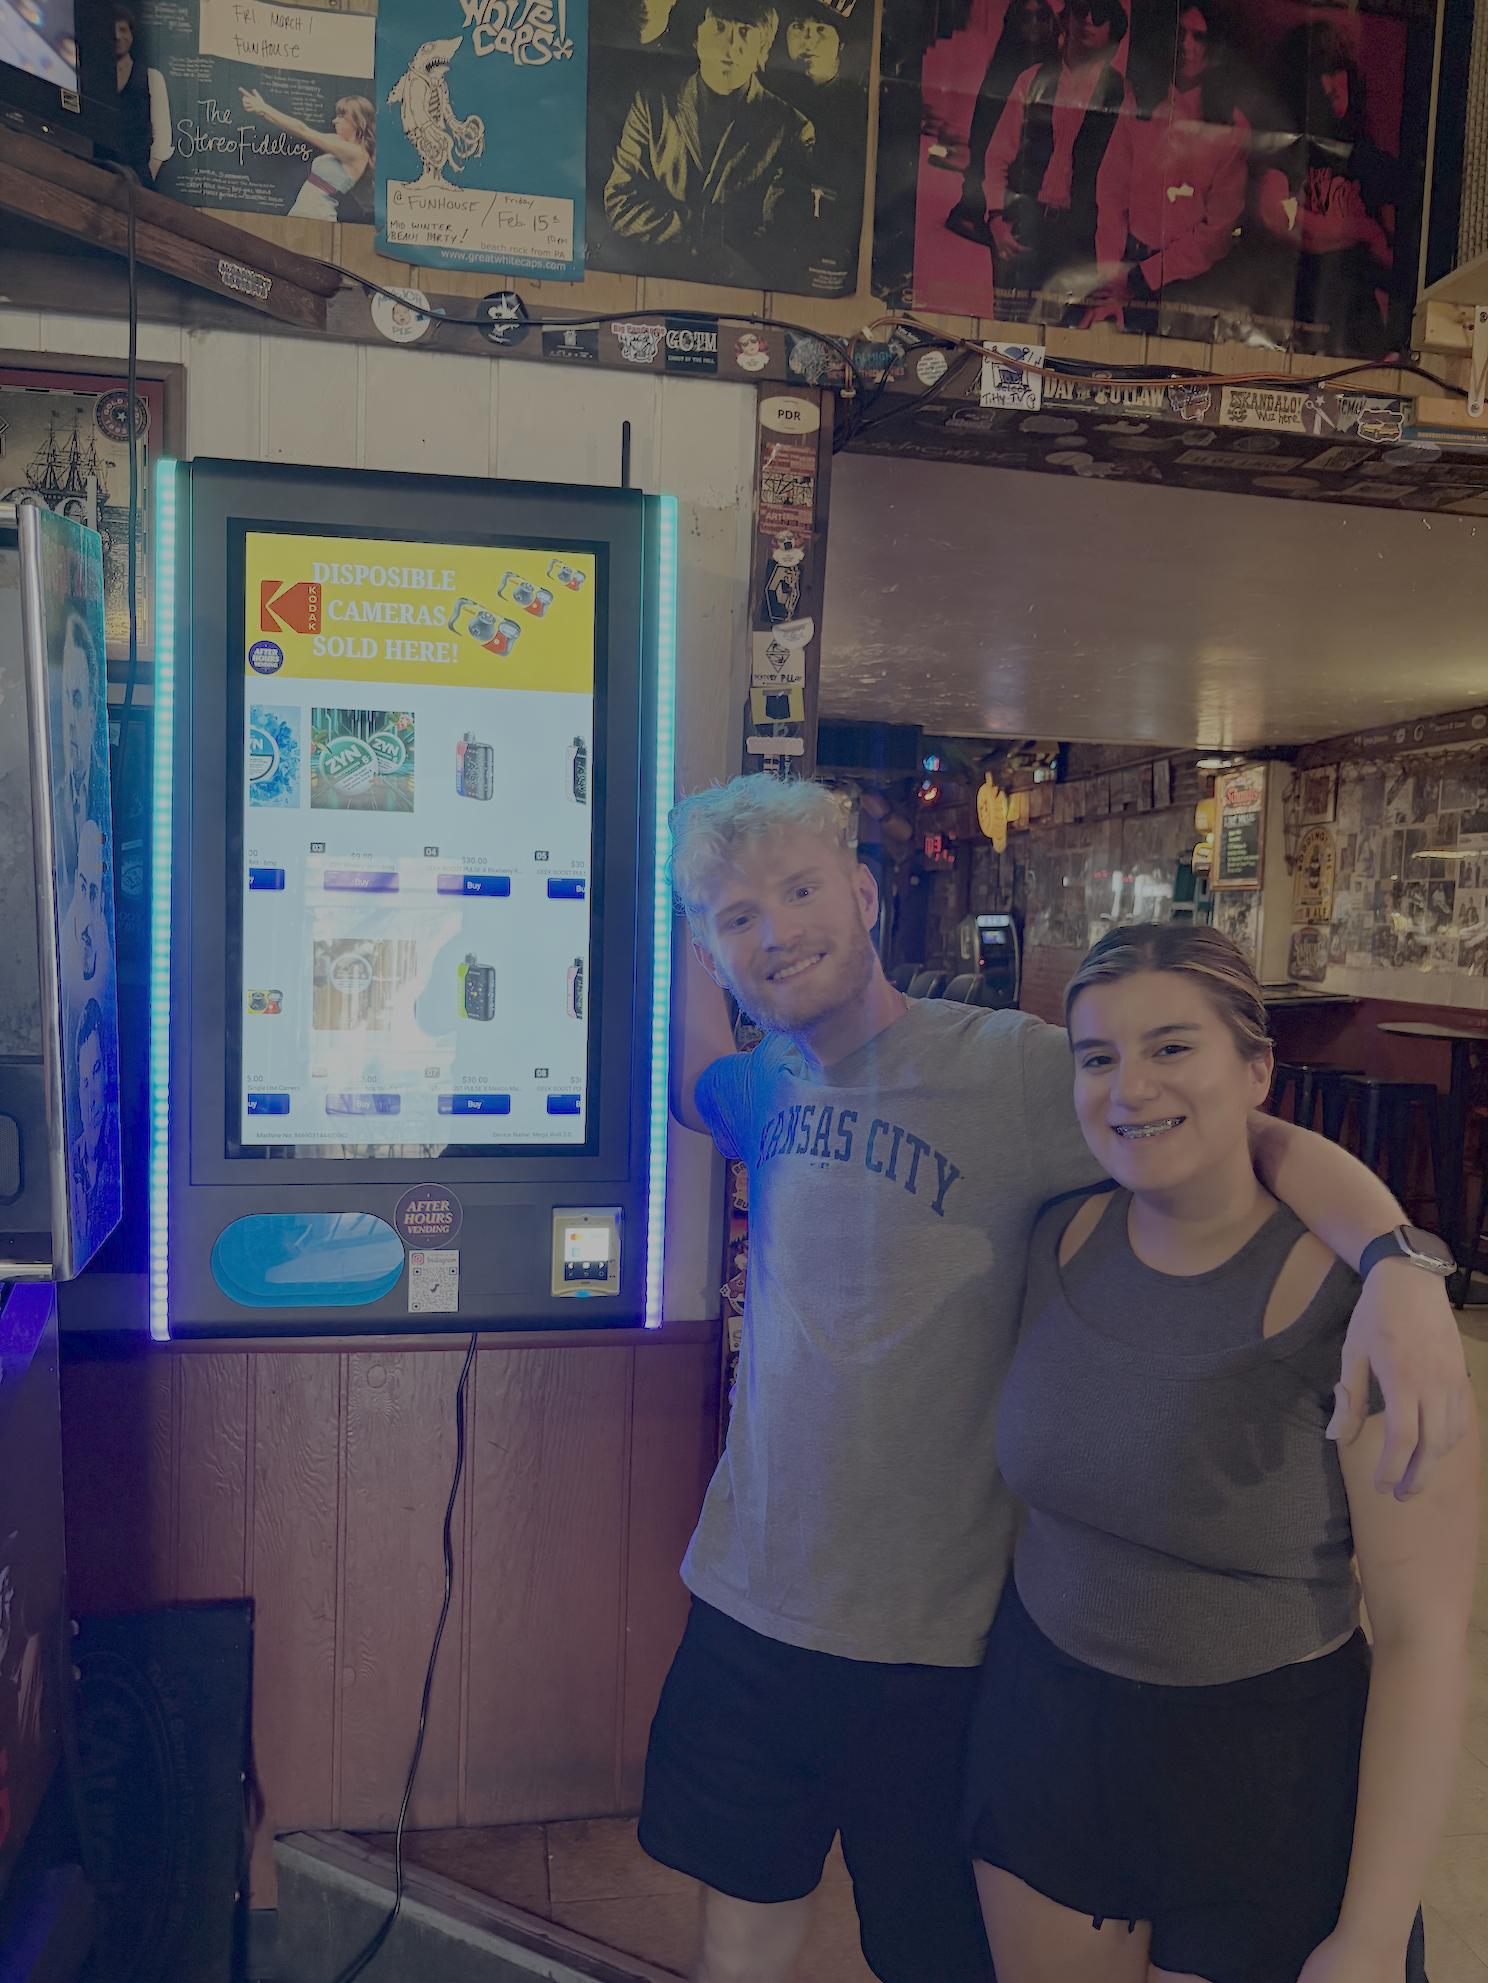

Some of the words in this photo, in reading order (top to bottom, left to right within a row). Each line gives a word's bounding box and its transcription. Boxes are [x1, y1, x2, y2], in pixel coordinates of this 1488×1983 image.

[198, 99, 233, 125] The
[176, 118, 313, 166] StereoFidelics
[407, 194, 480, 213] FUNHOUSE
[390, 220, 406, 230] MID
[411, 222, 453, 232] WINTER
[388, 231, 418, 242] BEACH
[480, 241, 507, 253] beach
[509, 244, 528, 254] rock
[530, 247, 551, 257] from
[554, 250, 565, 258] PA
[441, 250, 567, 271] www.greatwhitecaps.com
[777, 409, 801, 421] PDR
[312, 561, 457, 592] DISPOSIBLE
[307, 585, 318, 631] KODAK
[328, 599, 447, 628] CAMERAS
[313, 635, 379, 660] SOLD
[384, 638, 459, 664] HERE!
[250, 738, 264, 750] YN
[372, 737, 400, 757] ZYN
[324, 744, 363, 775] ZYN
[312, 843, 324, 852] 03
[425, 848, 437, 856] 04
[351, 852, 373, 860] $9.00
[461, 856, 488, 865] $30.00
[535, 852, 548, 861] 05
[354, 878, 369, 887] Buy
[466, 881, 482, 891] Buy
[536, 1069, 548, 1077] 08
[356, 1100, 371, 1109] Buy
[467, 1100, 483, 1110] Buy
[865, 1118, 961, 1217] CITY
[406, 1200, 450, 1212] AFTER
[404, 1212, 453, 1225] HOURS
[407, 1224, 450, 1234] VENDING
[427, 1256, 457, 1266] Instagram
